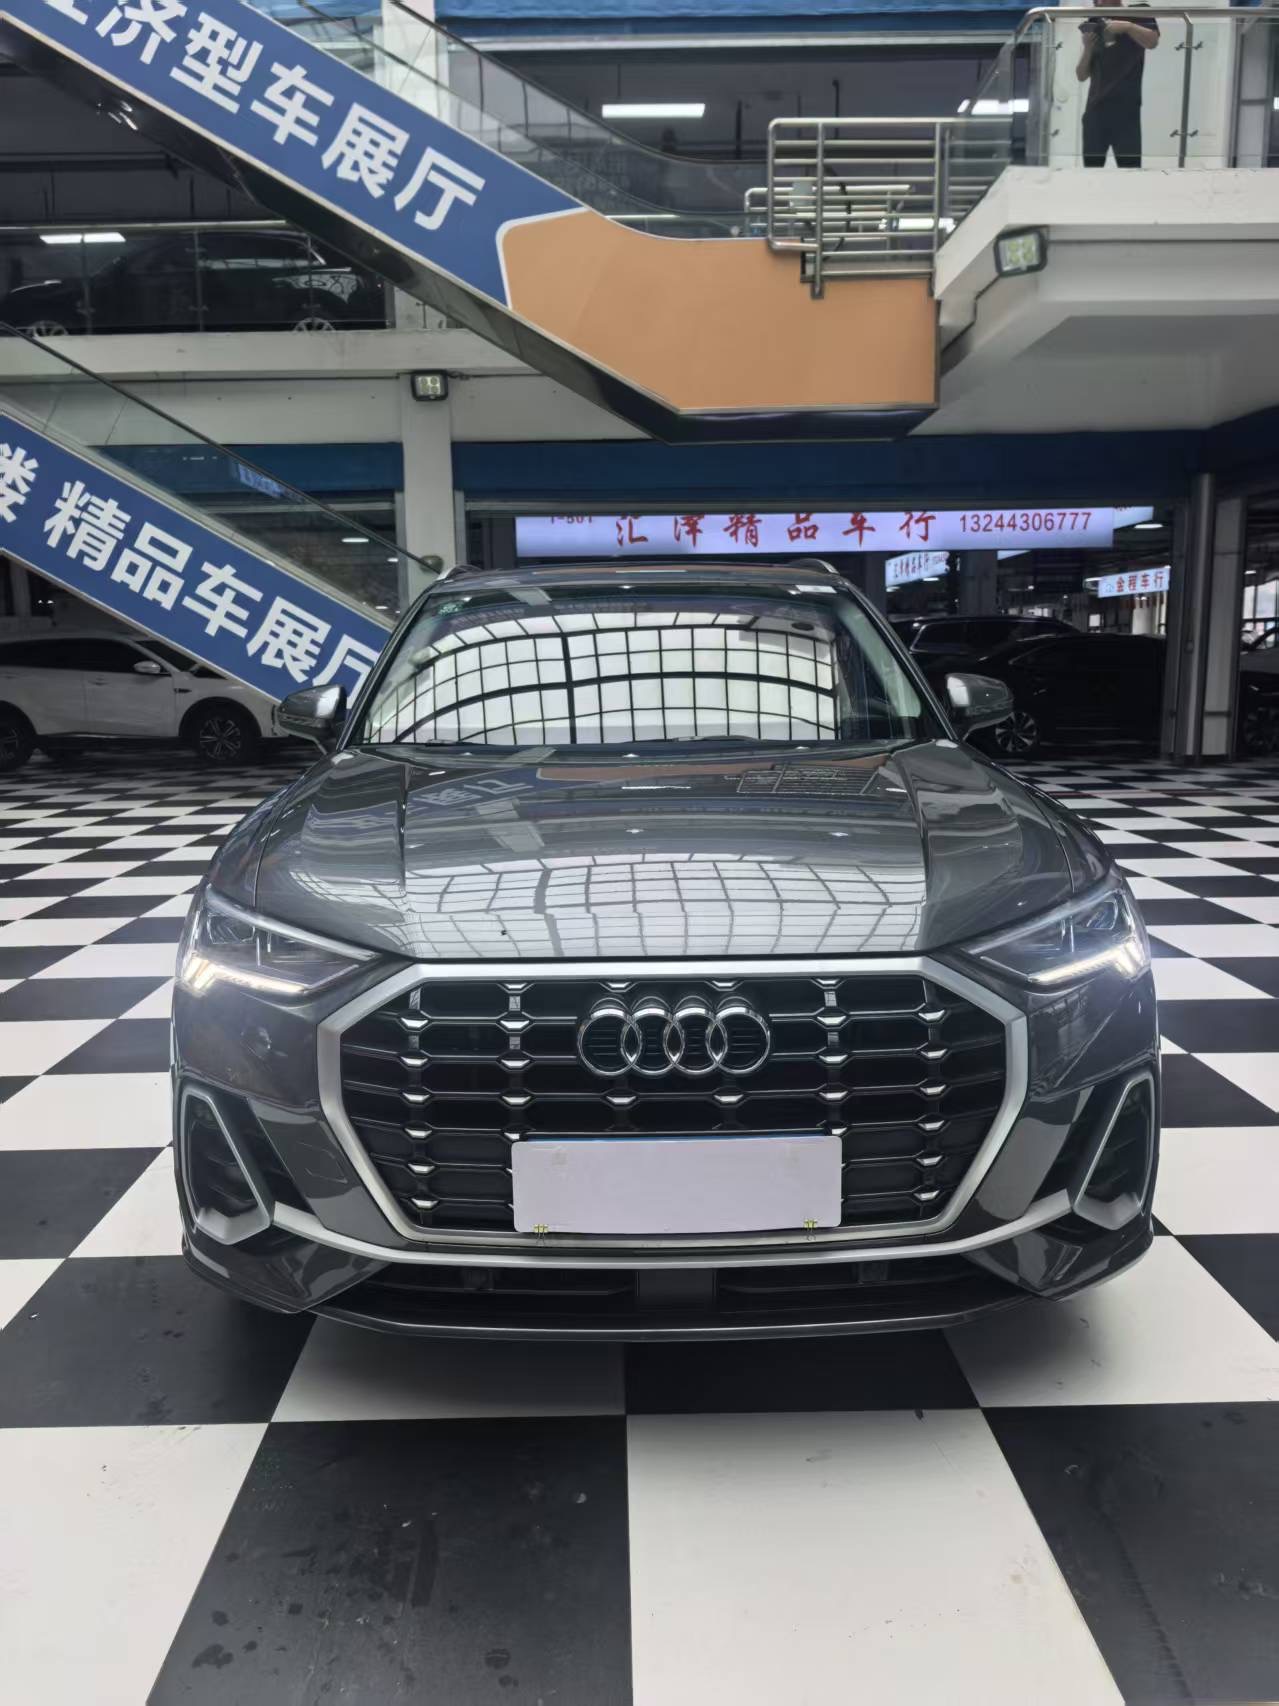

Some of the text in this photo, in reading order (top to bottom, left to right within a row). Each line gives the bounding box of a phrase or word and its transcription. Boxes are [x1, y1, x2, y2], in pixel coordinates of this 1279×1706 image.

[959, 511, 1092, 533] 13244306777
[44, 480, 381, 709] 精品车展厅
